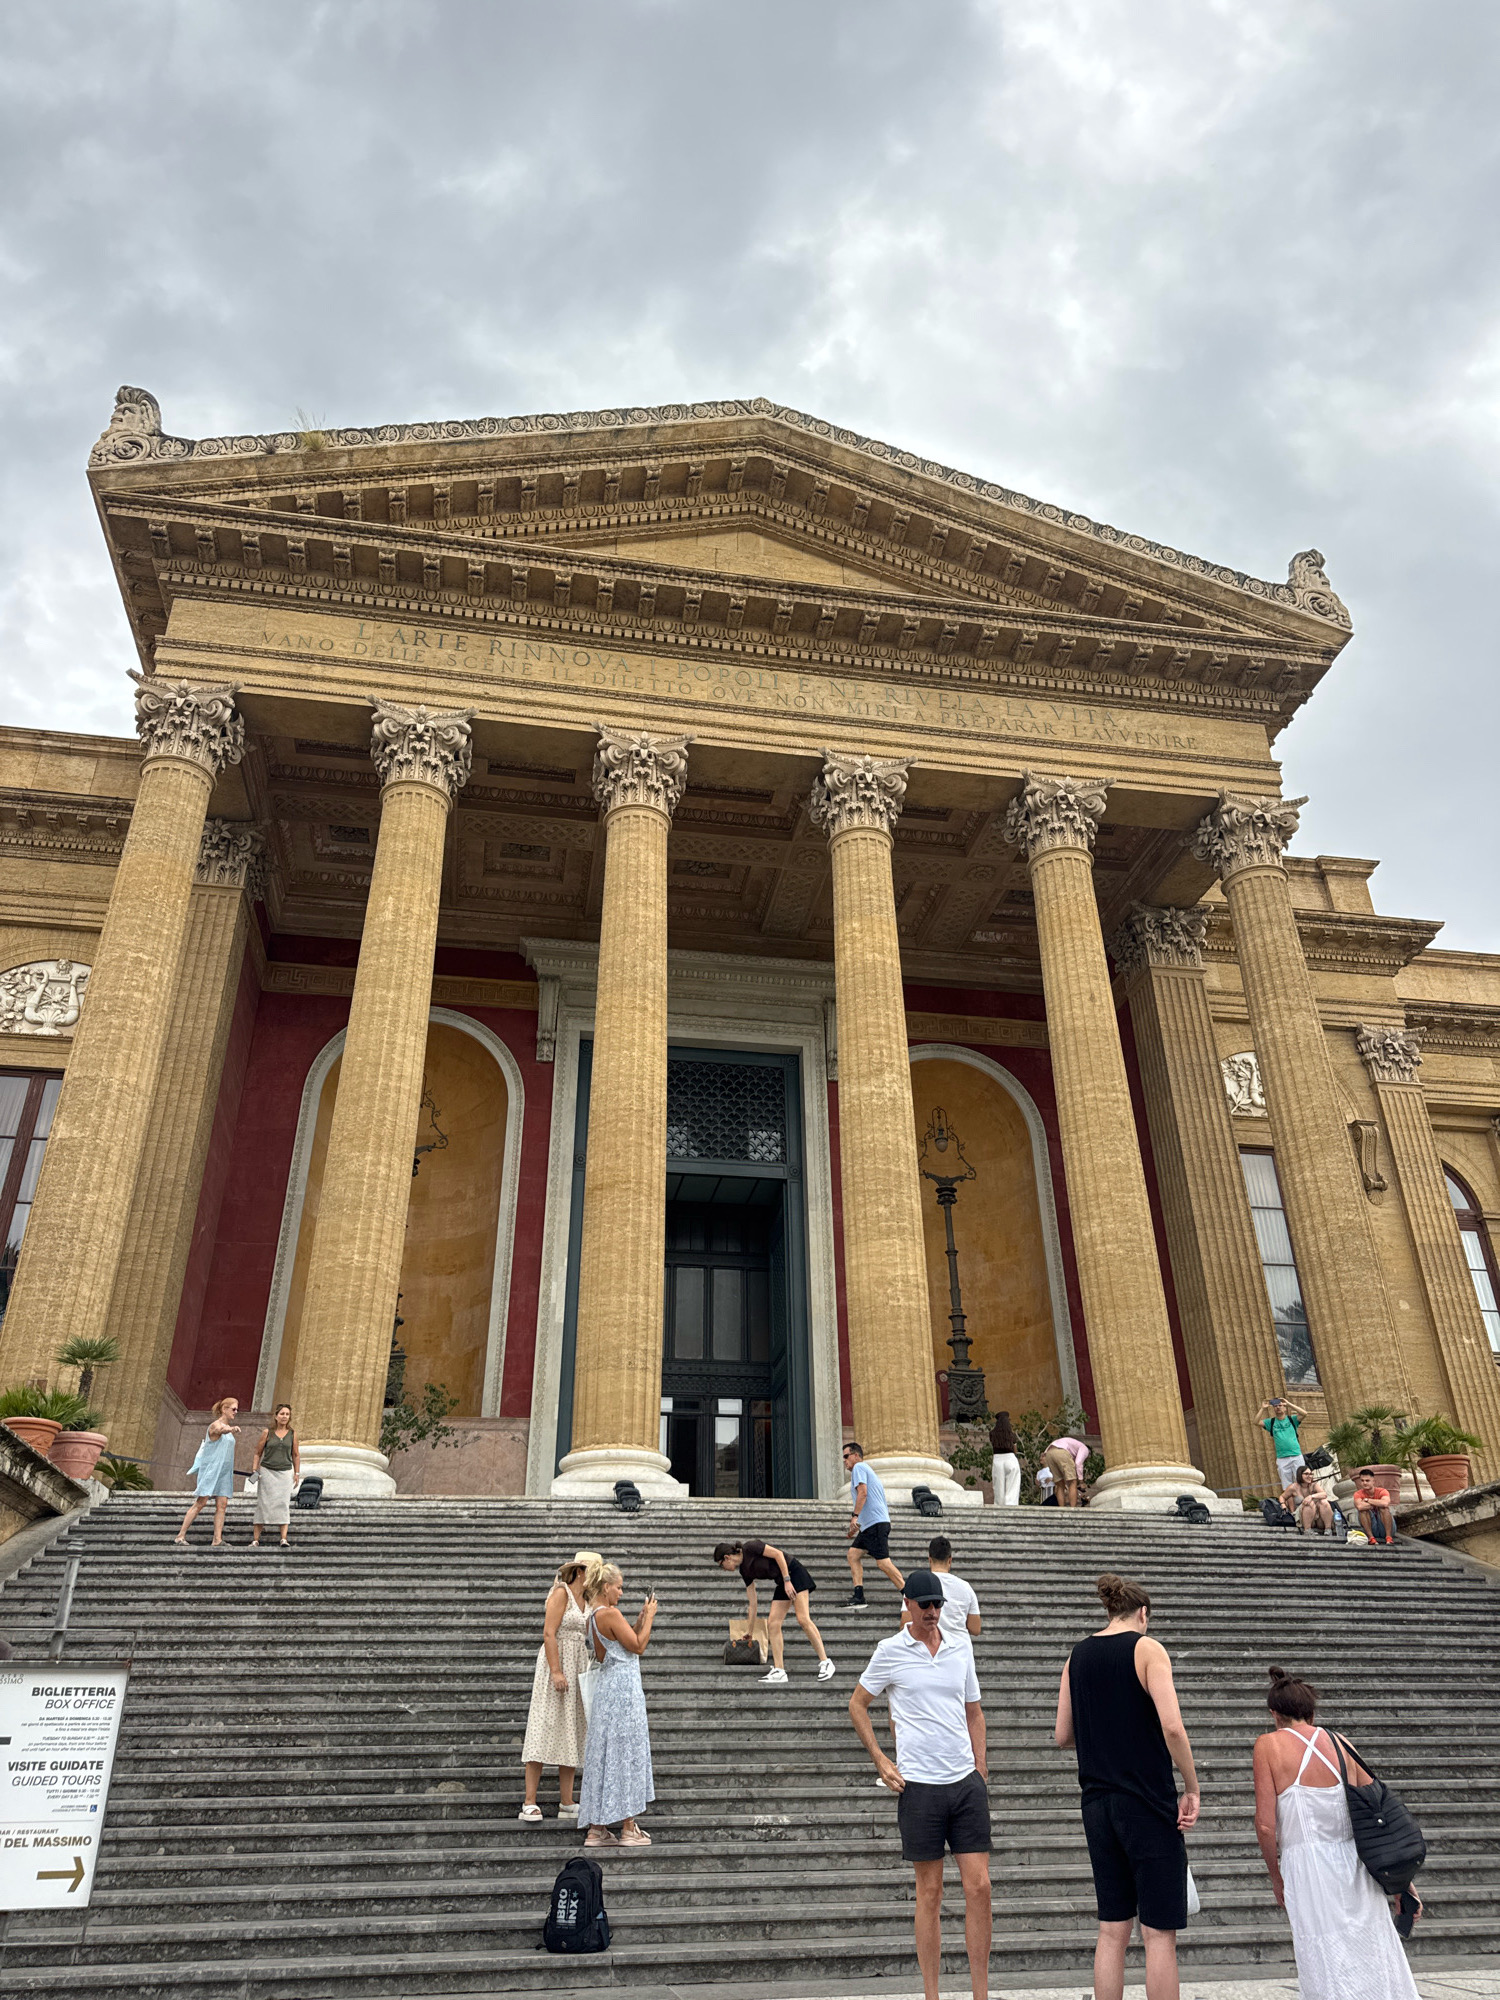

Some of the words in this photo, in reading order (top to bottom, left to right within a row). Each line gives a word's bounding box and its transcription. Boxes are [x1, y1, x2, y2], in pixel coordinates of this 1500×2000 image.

[489, 638, 631, 673] RINNOVA
[650, 659, 656, 676] I
[677, 662, 778, 690] POPOLI
[799, 677, 811, 694] E
[829, 680, 865, 700] NE
[885, 686, 988, 714] RIVELA
[1006, 700, 1037, 719] LA
[1050, 704, 1118, 728] VITA
[262, 631, 334, 651] VANO
[353, 641, 426, 663] DELLE
[447, 653, 533, 676] SCENE
[552, 665, 574, 682] IL
[592, 671, 691, 695] DILETTO
[713, 686, 757, 703] OVE
[776, 692, 825, 711] NON
[847, 700, 898, 719] MIRI
[914, 710, 926, 722] A
[941, 710, 1057, 736] PREPARAR
[1073, 724, 1199, 750] L'AVVENIRE
[32, 1687, 116, 1696] BIGLIETTERIA
[45, 1699, 71, 1709] BOX
[73, 1699, 115, 1709] OFFICE
[8, 1761, 46, 1771] VISITE
[50, 1761, 104, 1771] GUIDATE
[12, 1776, 58, 1786] GUIDED
[62, 1775, 102, 1786] TOURS
[4, 1838, 29, 1848] DEL
[33, 1836, 92, 1848] MASSIMO
